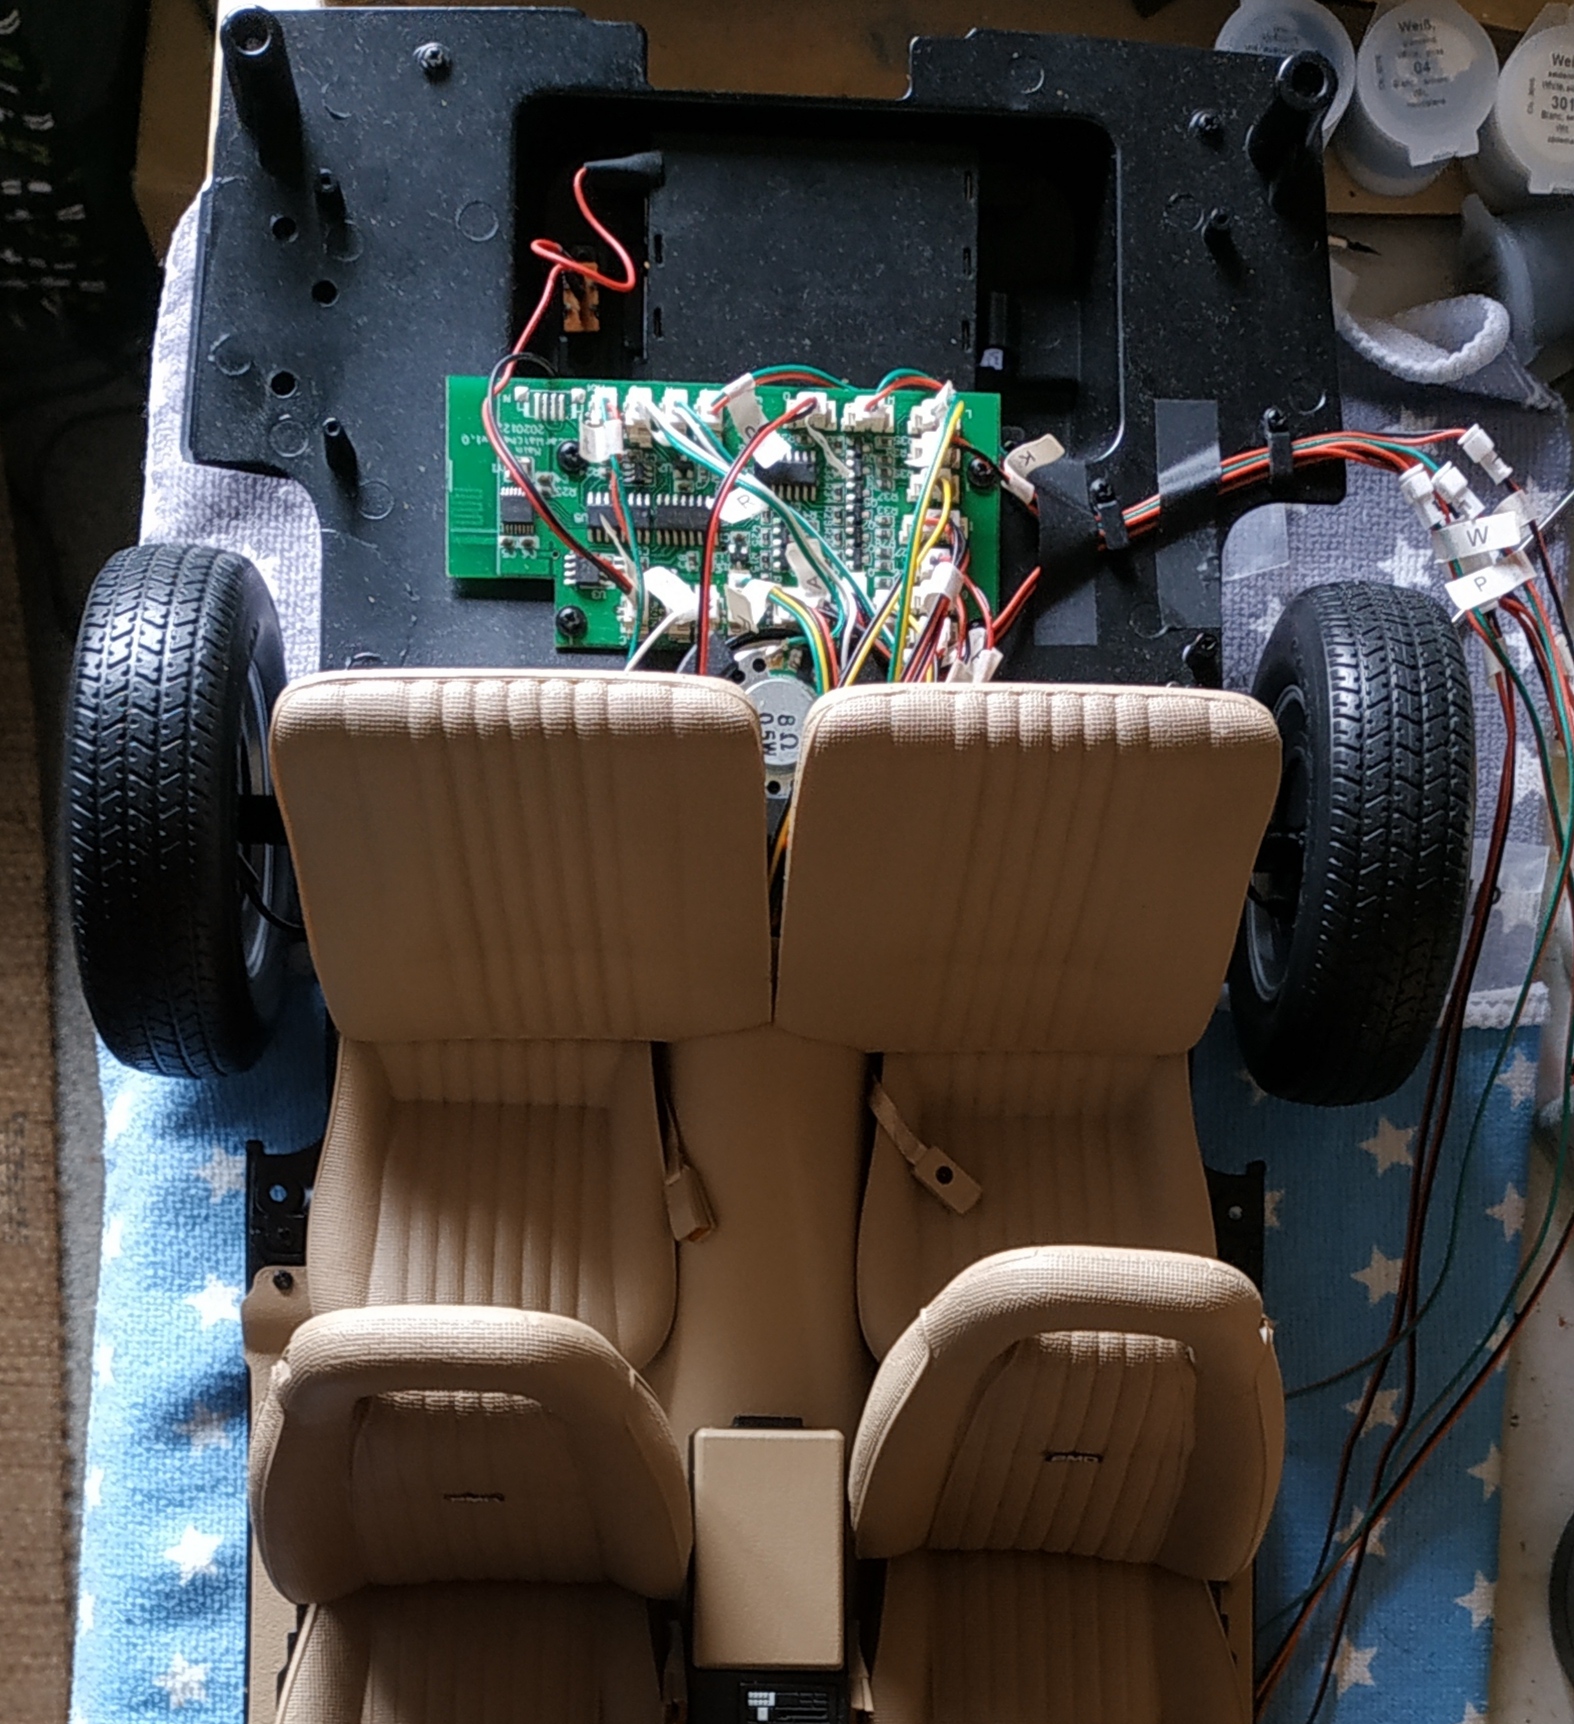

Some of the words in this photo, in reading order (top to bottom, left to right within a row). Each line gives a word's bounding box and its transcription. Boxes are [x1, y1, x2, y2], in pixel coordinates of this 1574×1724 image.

[1413, 61, 1432, 75] 04
[1466, 525, 1489, 548] W
[1473, 576, 1488, 593] P
